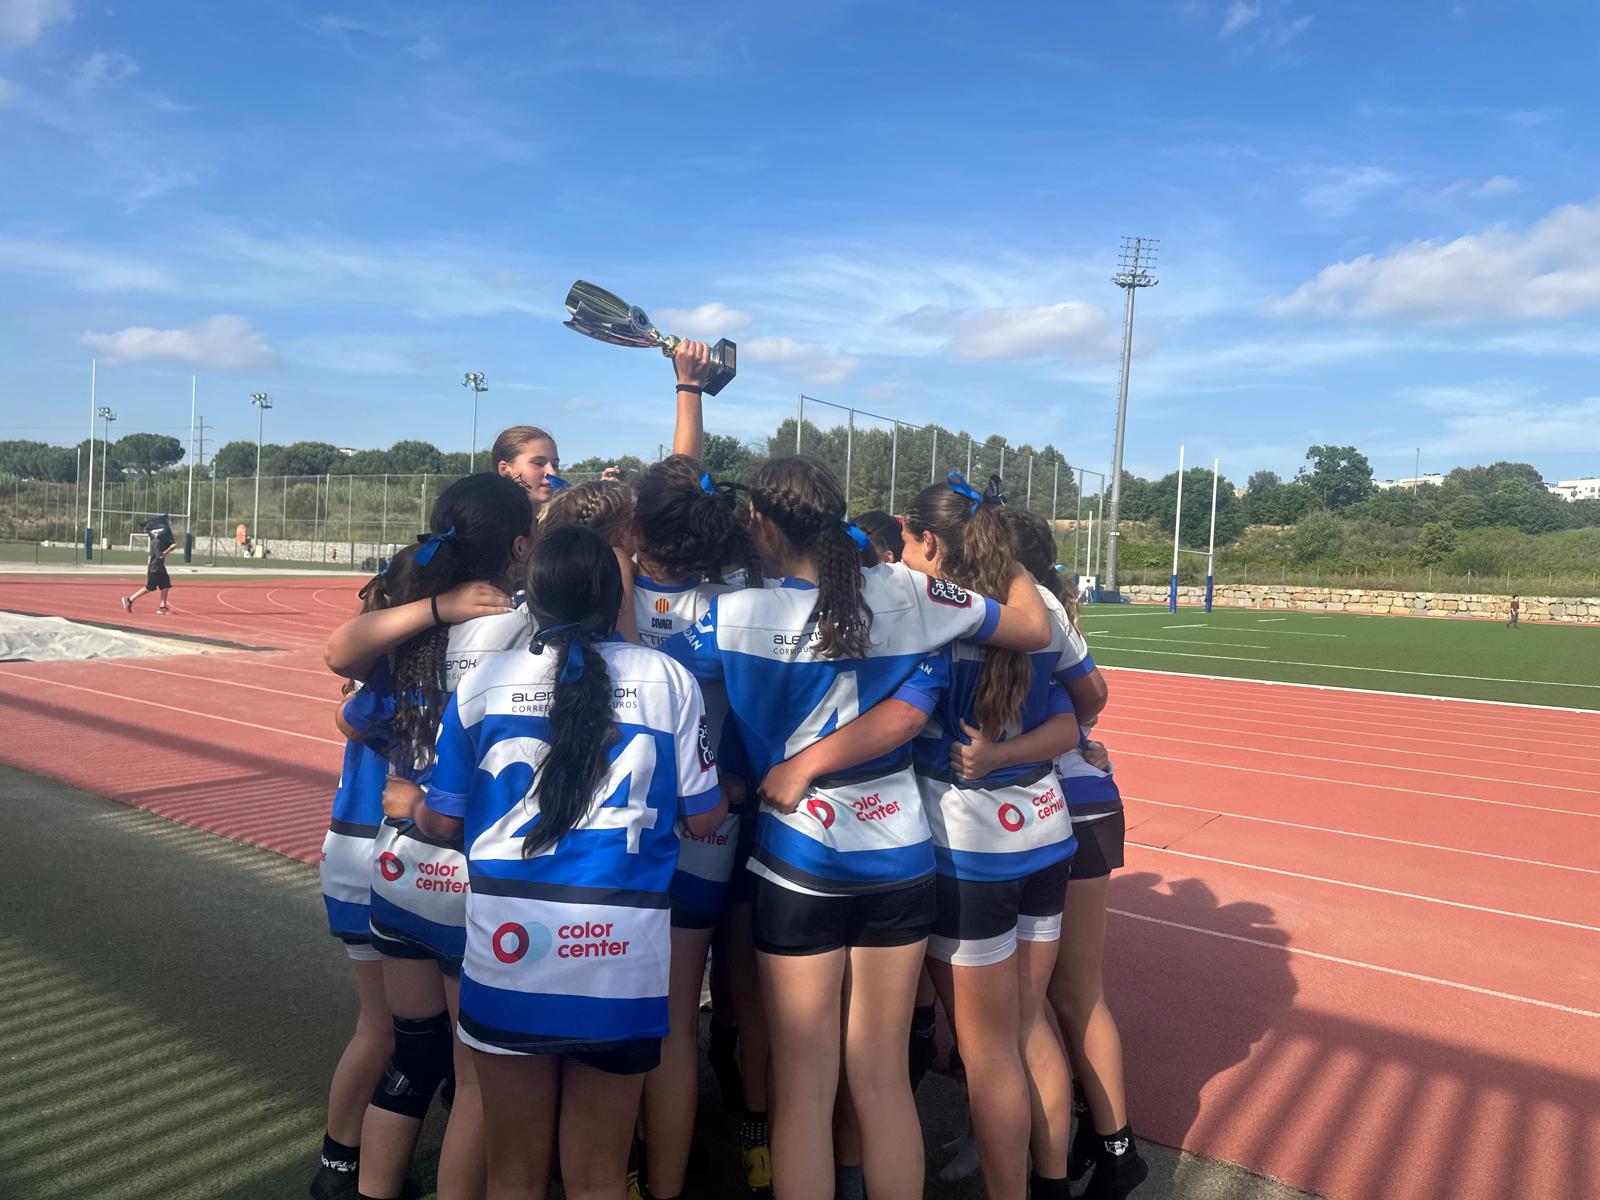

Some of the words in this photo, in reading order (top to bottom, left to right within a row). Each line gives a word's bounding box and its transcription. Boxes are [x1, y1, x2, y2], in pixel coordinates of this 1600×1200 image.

[469, 733, 658, 861] 24
[418, 862, 459, 877] color
[416, 877, 470, 894] center
[558, 921, 614, 940] color
[558, 940, 630, 958] center
